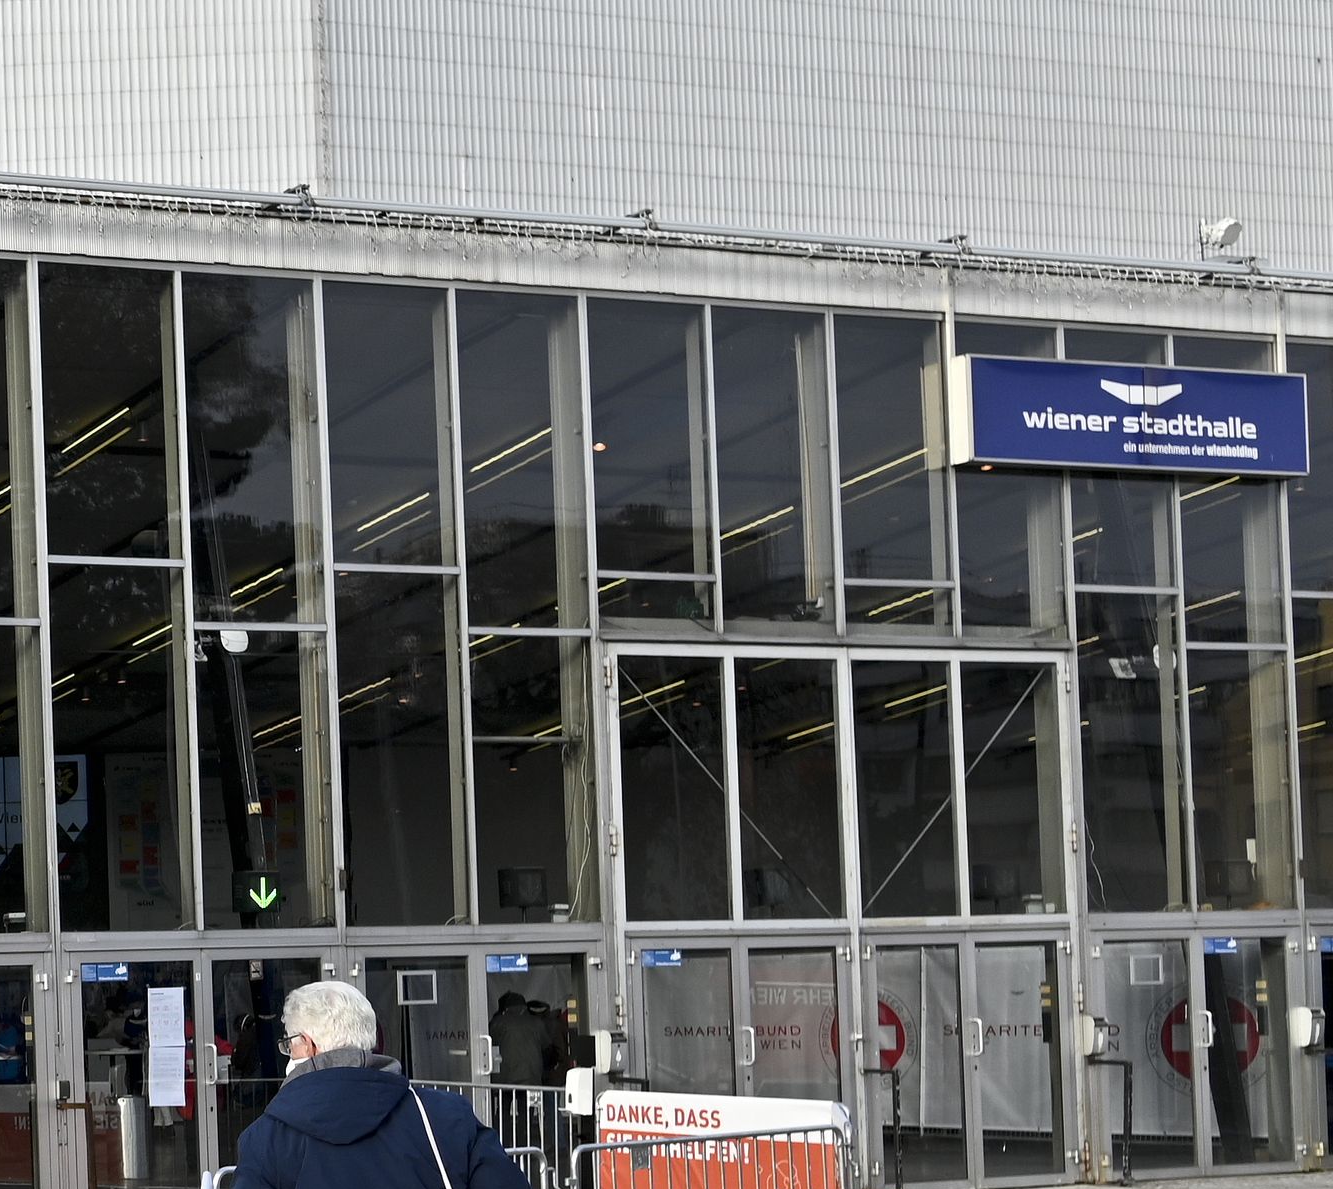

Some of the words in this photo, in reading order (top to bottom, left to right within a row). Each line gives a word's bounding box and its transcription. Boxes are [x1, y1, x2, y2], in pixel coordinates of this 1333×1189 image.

[1022, 406, 1116, 433] wiener
[1122, 412, 1257, 440] stadthalle
[1123, 440, 1137, 453] ein
[1138, 441, 1190, 456] unternehmen
[1191, 445, 1205, 457] der
[760, 1039, 802, 1050] WIEN
[606, 1104, 668, 1129] DANKE,
[674, 1108, 721, 1129] DASS
